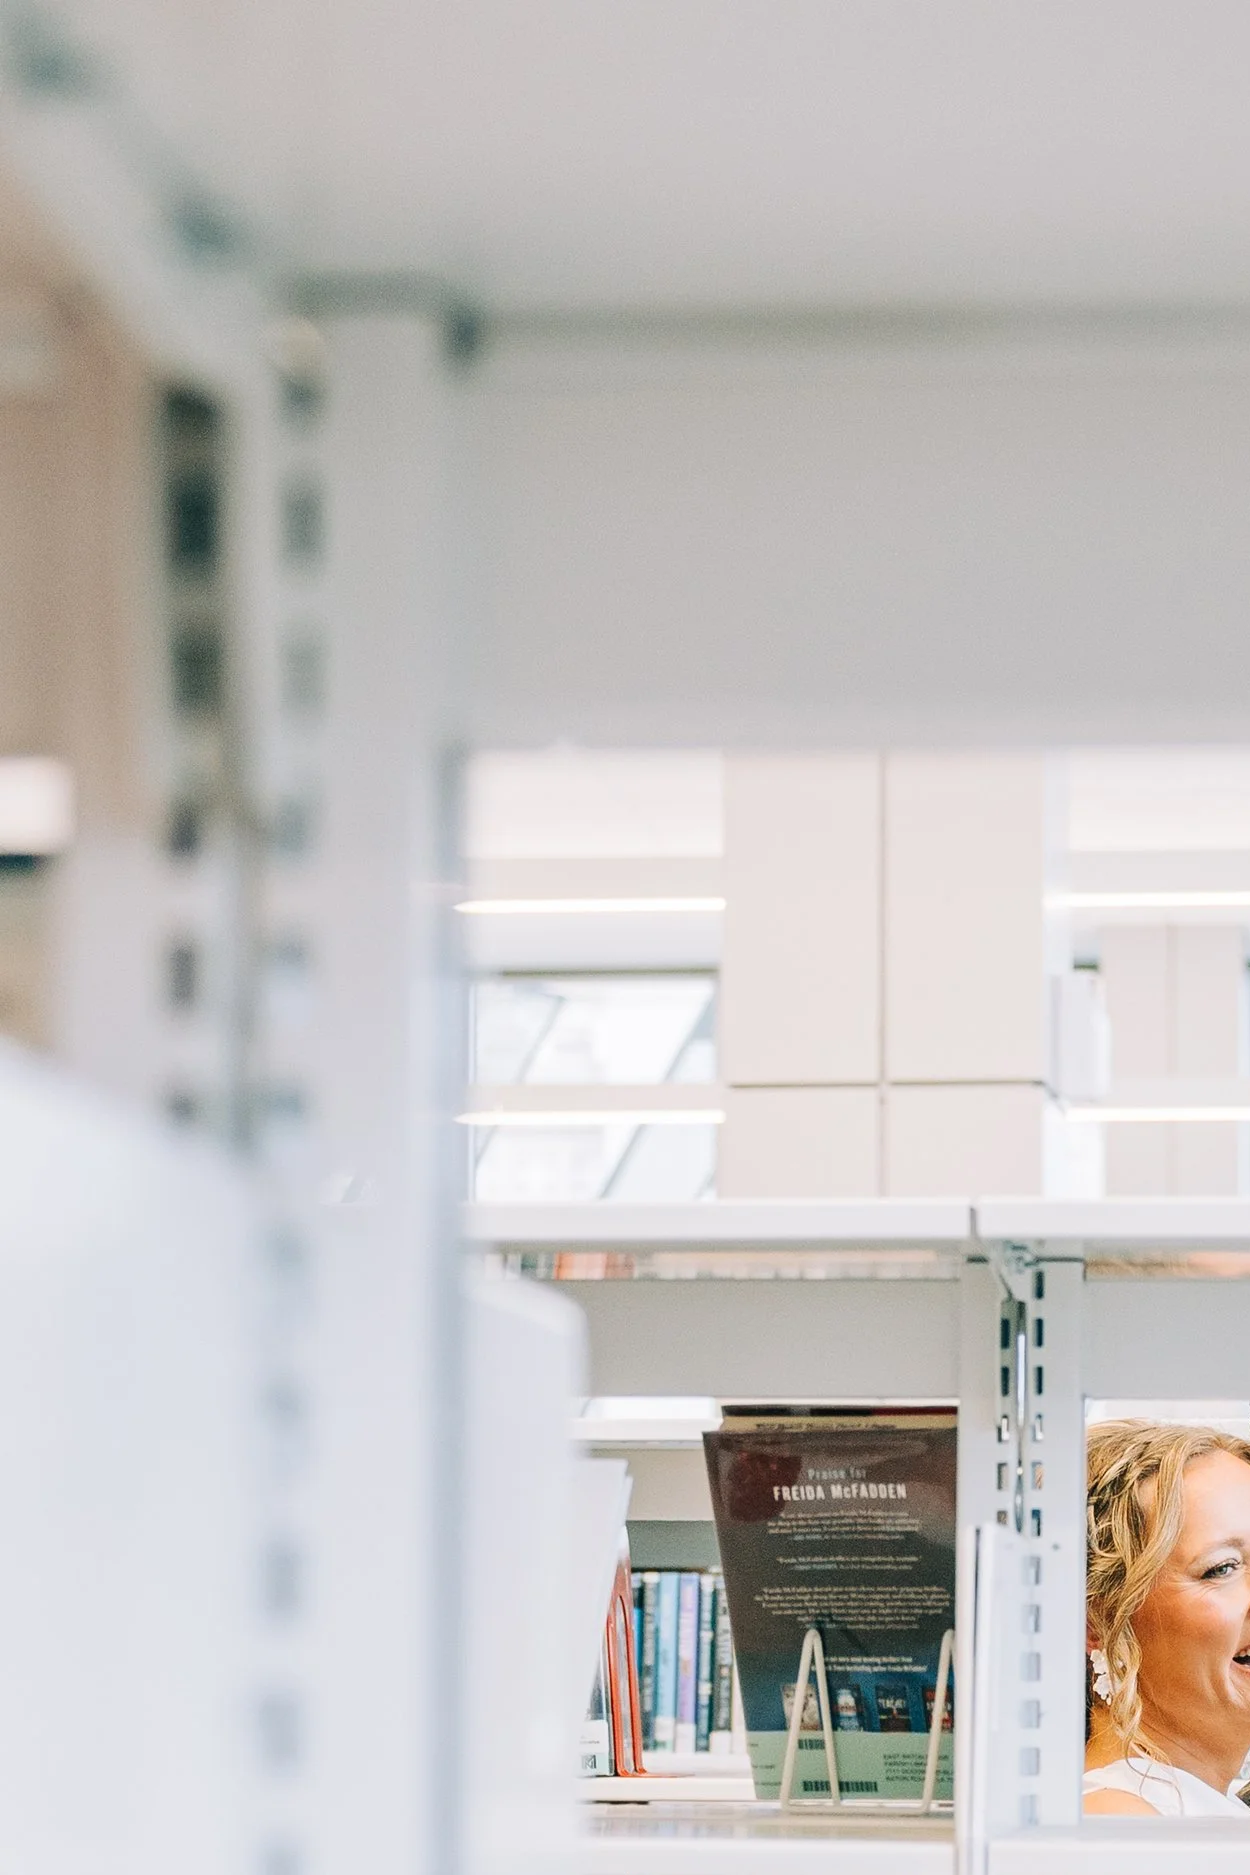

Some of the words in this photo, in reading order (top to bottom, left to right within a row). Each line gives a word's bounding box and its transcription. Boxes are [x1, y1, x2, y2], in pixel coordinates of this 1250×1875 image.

[807, 1468, 846, 1480] Praise
[772, 1485, 826, 1501] FREIDA
[829, 1482, 907, 1499] McFADDEN
